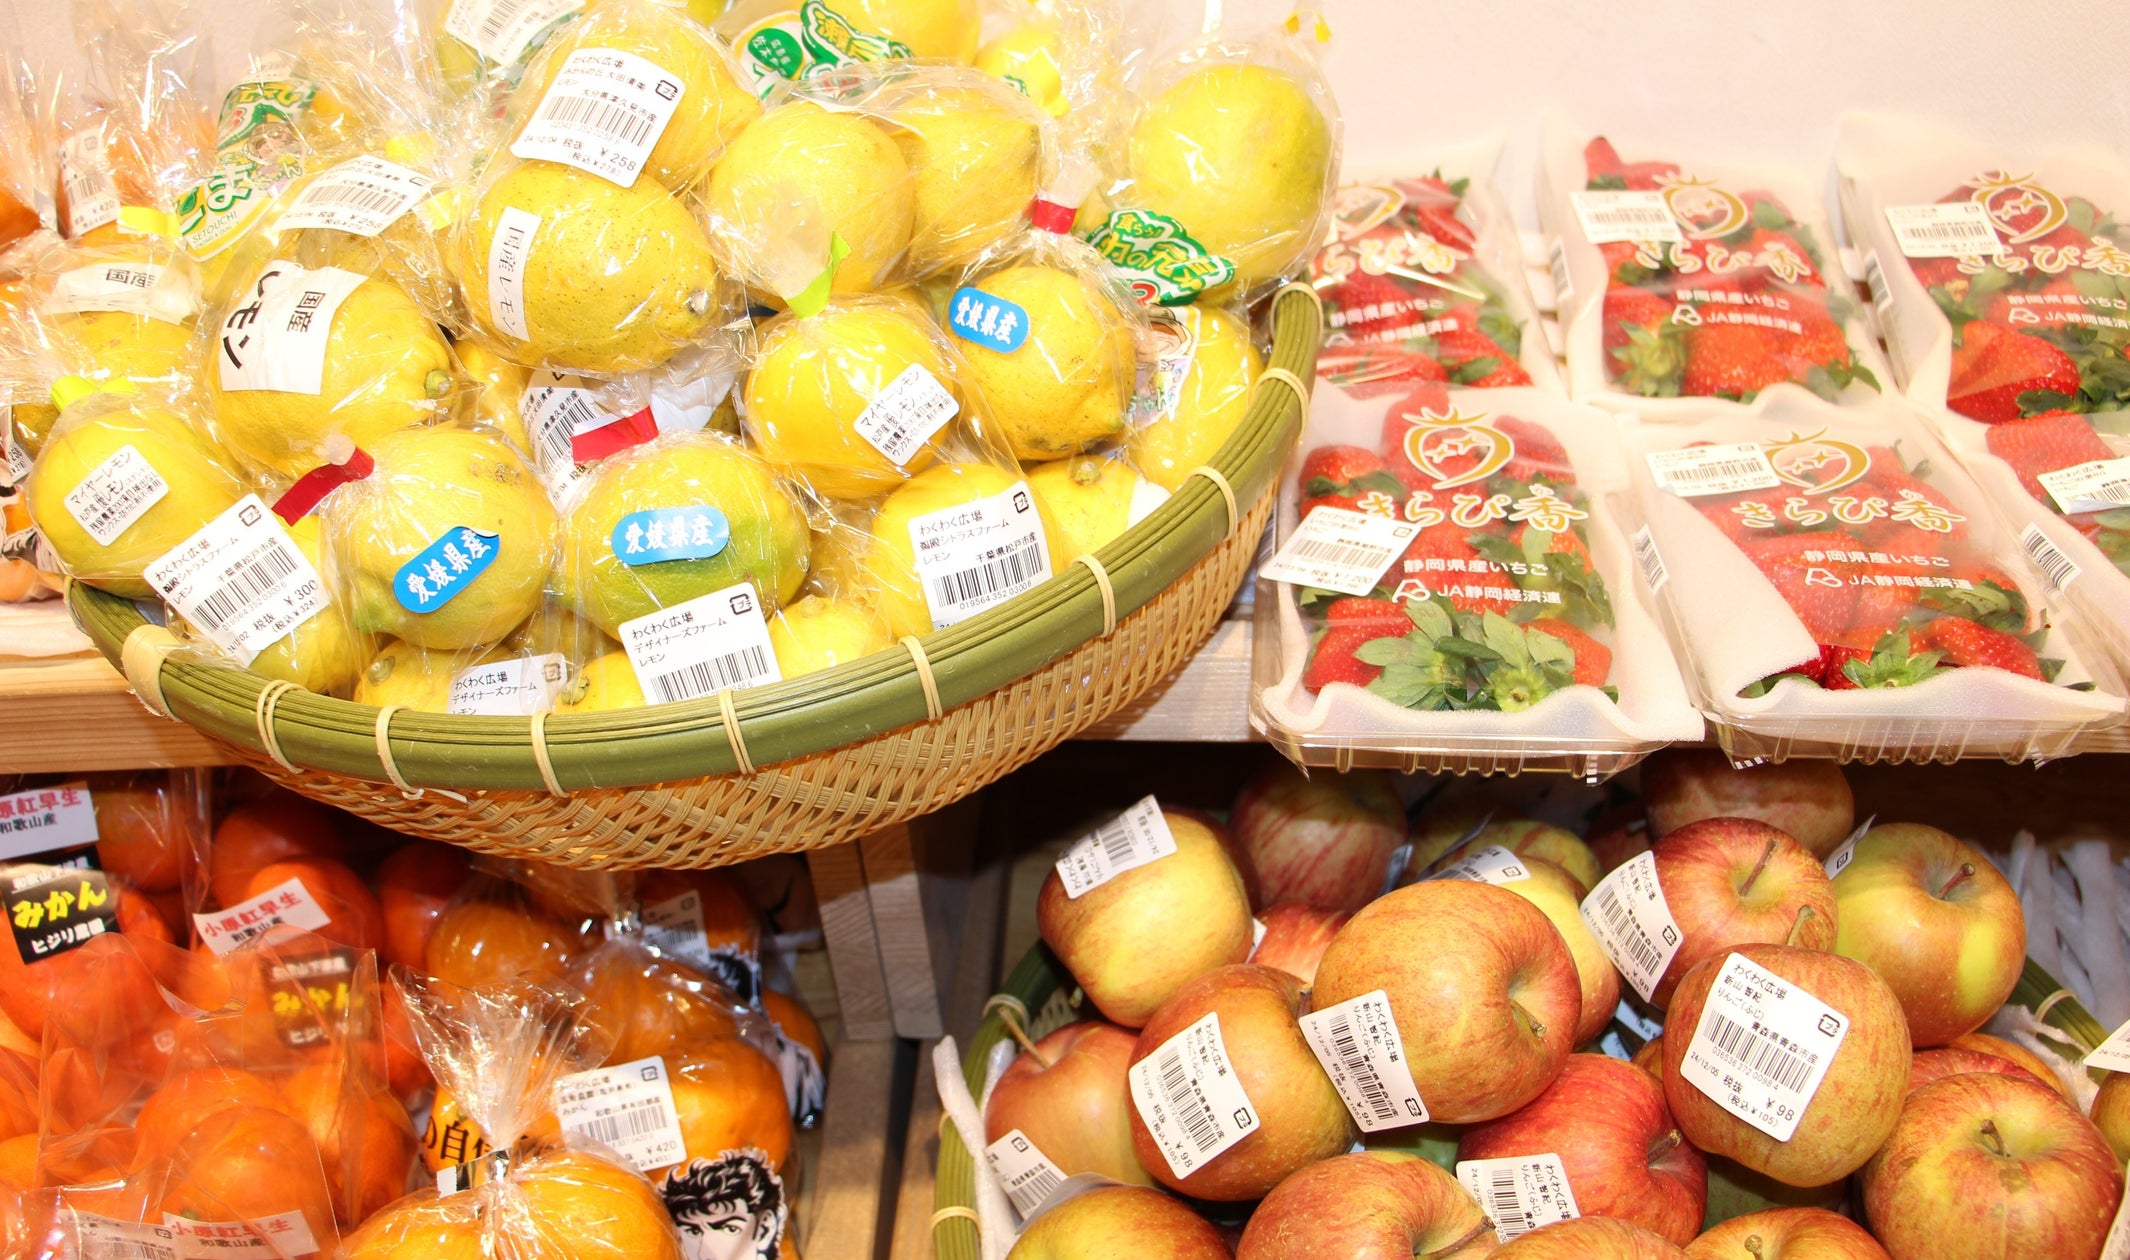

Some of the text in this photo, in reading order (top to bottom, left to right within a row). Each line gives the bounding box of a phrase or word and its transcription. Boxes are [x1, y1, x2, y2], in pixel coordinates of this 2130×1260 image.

[223, 271, 282, 370] レモン
[287, 291, 326, 333] 国産
[954, 296, 1018, 345] 愛媛県産
[70, 452, 131, 504] マイヤーレモン
[920, 509, 983, 536] わくわく広場
[1357, 483, 1589, 533] きらぴ香
[1731, 489, 1967, 533] きらぴ香
[624, 515, 715, 555] 愛媛県産
[976, 532, 1038, 563] 千葉県松戸市産
[155, 539, 211, 582] わくわく広場
[406, 528, 492, 605] 愛媛県産
[922, 551, 951, 566] レモン
[1403, 559, 1549, 577] 静岡県産いちご
[1803, 550, 1949, 567] 静岡県産いちご
[173, 585, 193, 604] レモン
[959, 595, 991, 610] 019564
[992, 590, 1007, 600] 352
[1437, 584, 1561, 604] JA静岡経済連
[1849, 575, 1974, 591] JA静岡経済連
[632, 611, 695, 640] わくわく広場
[634, 617, 727, 653] デザイナーズファーム
[639, 653, 666, 667] レモン
[452, 682, 537, 705] デザイナーズファーム
[455, 671, 508, 691] わくわく広場
[0, 813, 57, 834] 和歌山産
[12, 881, 107, 929] みかん
[205, 891, 302, 937] 小原紅早生
[1724, 974, 1763, 1003] 新山 智紀
[1733, 962, 1788, 1000] わくわく広場
[1717, 987, 1765, 1020] りんご(ふじ)
[1205, 1024, 1227, 1077] わくわく広場
[1353, 1005, 1376, 1060] りんご(ふじ)
[1373, 1002, 1399, 1063] わくわく広場
[1751, 1020, 1820, 1066] 青森県青森市産
[1362, 1055, 1399, 1117] 青森県青森市産
[1690, 1051, 1796, 1121] 24/12/05 税抜 ¥98
[1712, 1045, 1738, 1067] 036536
[1736, 1062, 1752, 1077] 372
[1752, 1070, 1773, 1088] 0098
[1728, 1093, 1779, 1128] (税込¥105)
[1520, 1164, 1542, 1217] りんご(ふじ)
[1532, 1163, 1544, 1183] 新山
[1545, 1163, 1572, 1220] わくわく広場
